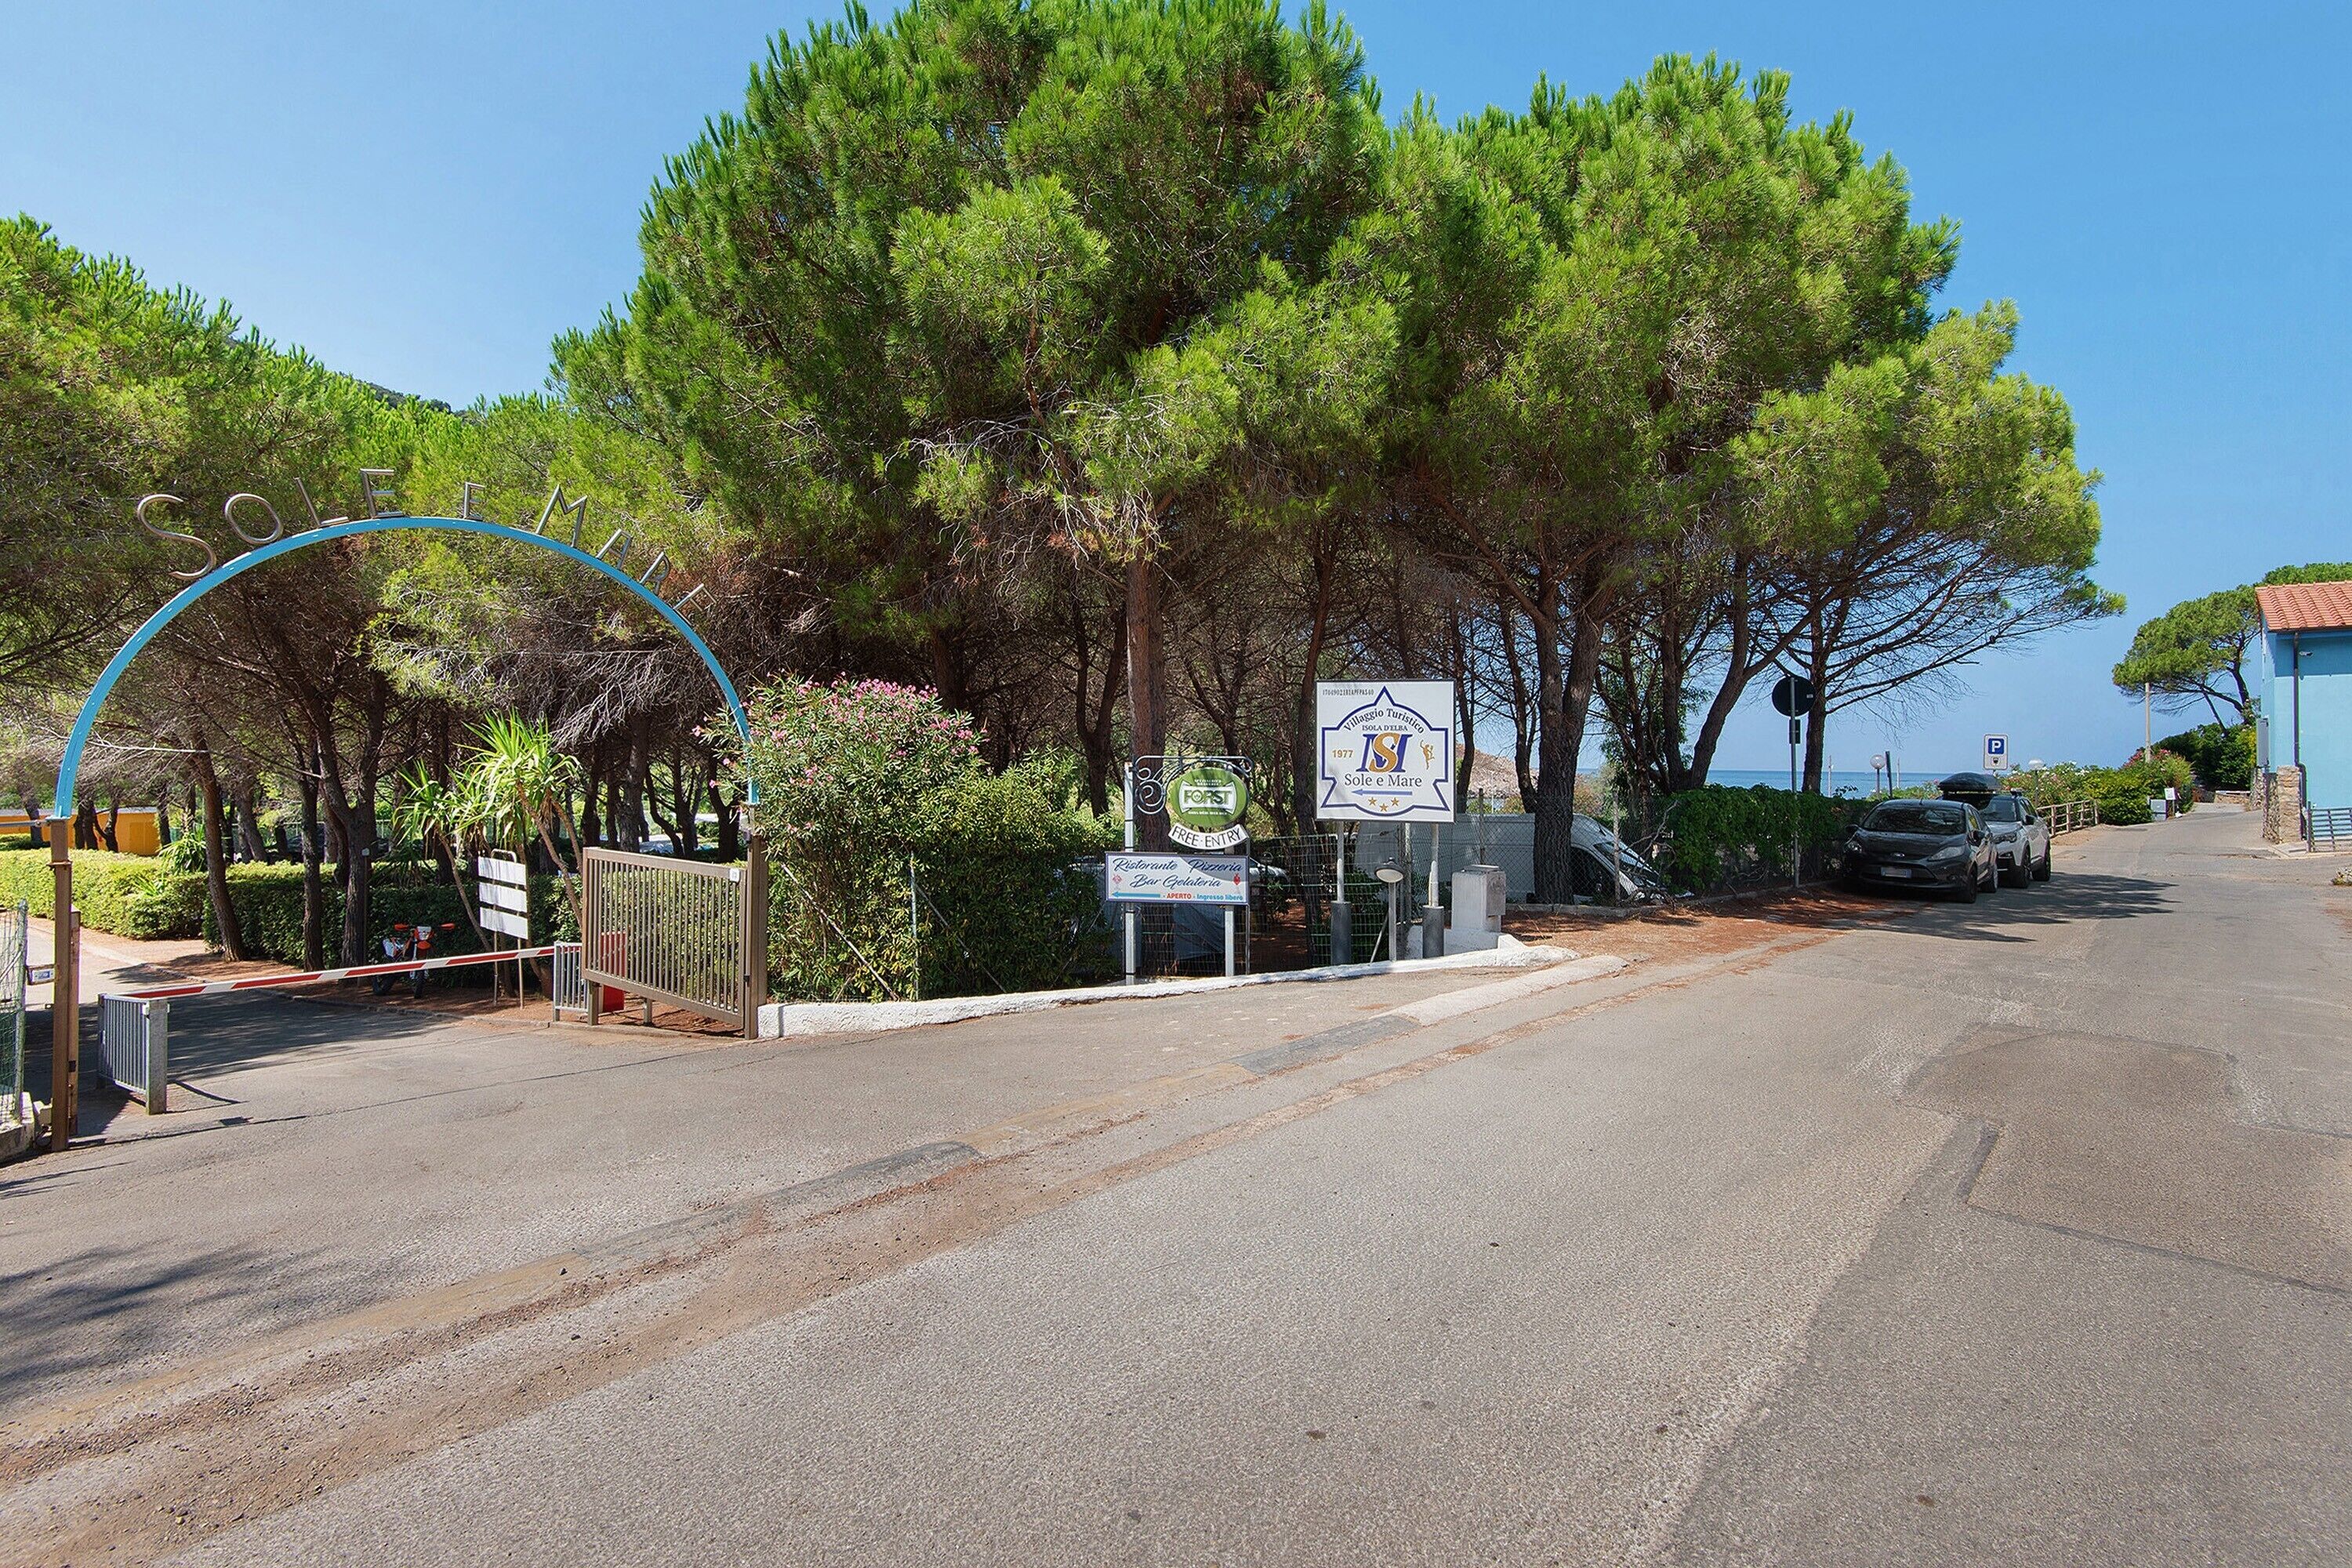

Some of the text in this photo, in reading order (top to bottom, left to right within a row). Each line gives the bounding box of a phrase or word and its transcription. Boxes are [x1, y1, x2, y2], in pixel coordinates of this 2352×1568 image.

[136, 468, 717, 626] SOLE E MARE
[1344, 708, 1425, 735] Villaggio Turistico
[1332, 750, 1353, 758] 1977
[1991, 740, 2002, 753] P
[1345, 774, 1422, 787] Sole e Mare
[1184, 789, 1232, 805] FORST
[1171, 826, 1242, 848] FREE ENTRY
[1112, 858, 1243, 873] Ristorante Pizzeria
[1130, 873, 1221, 890] Bar Gelateria
